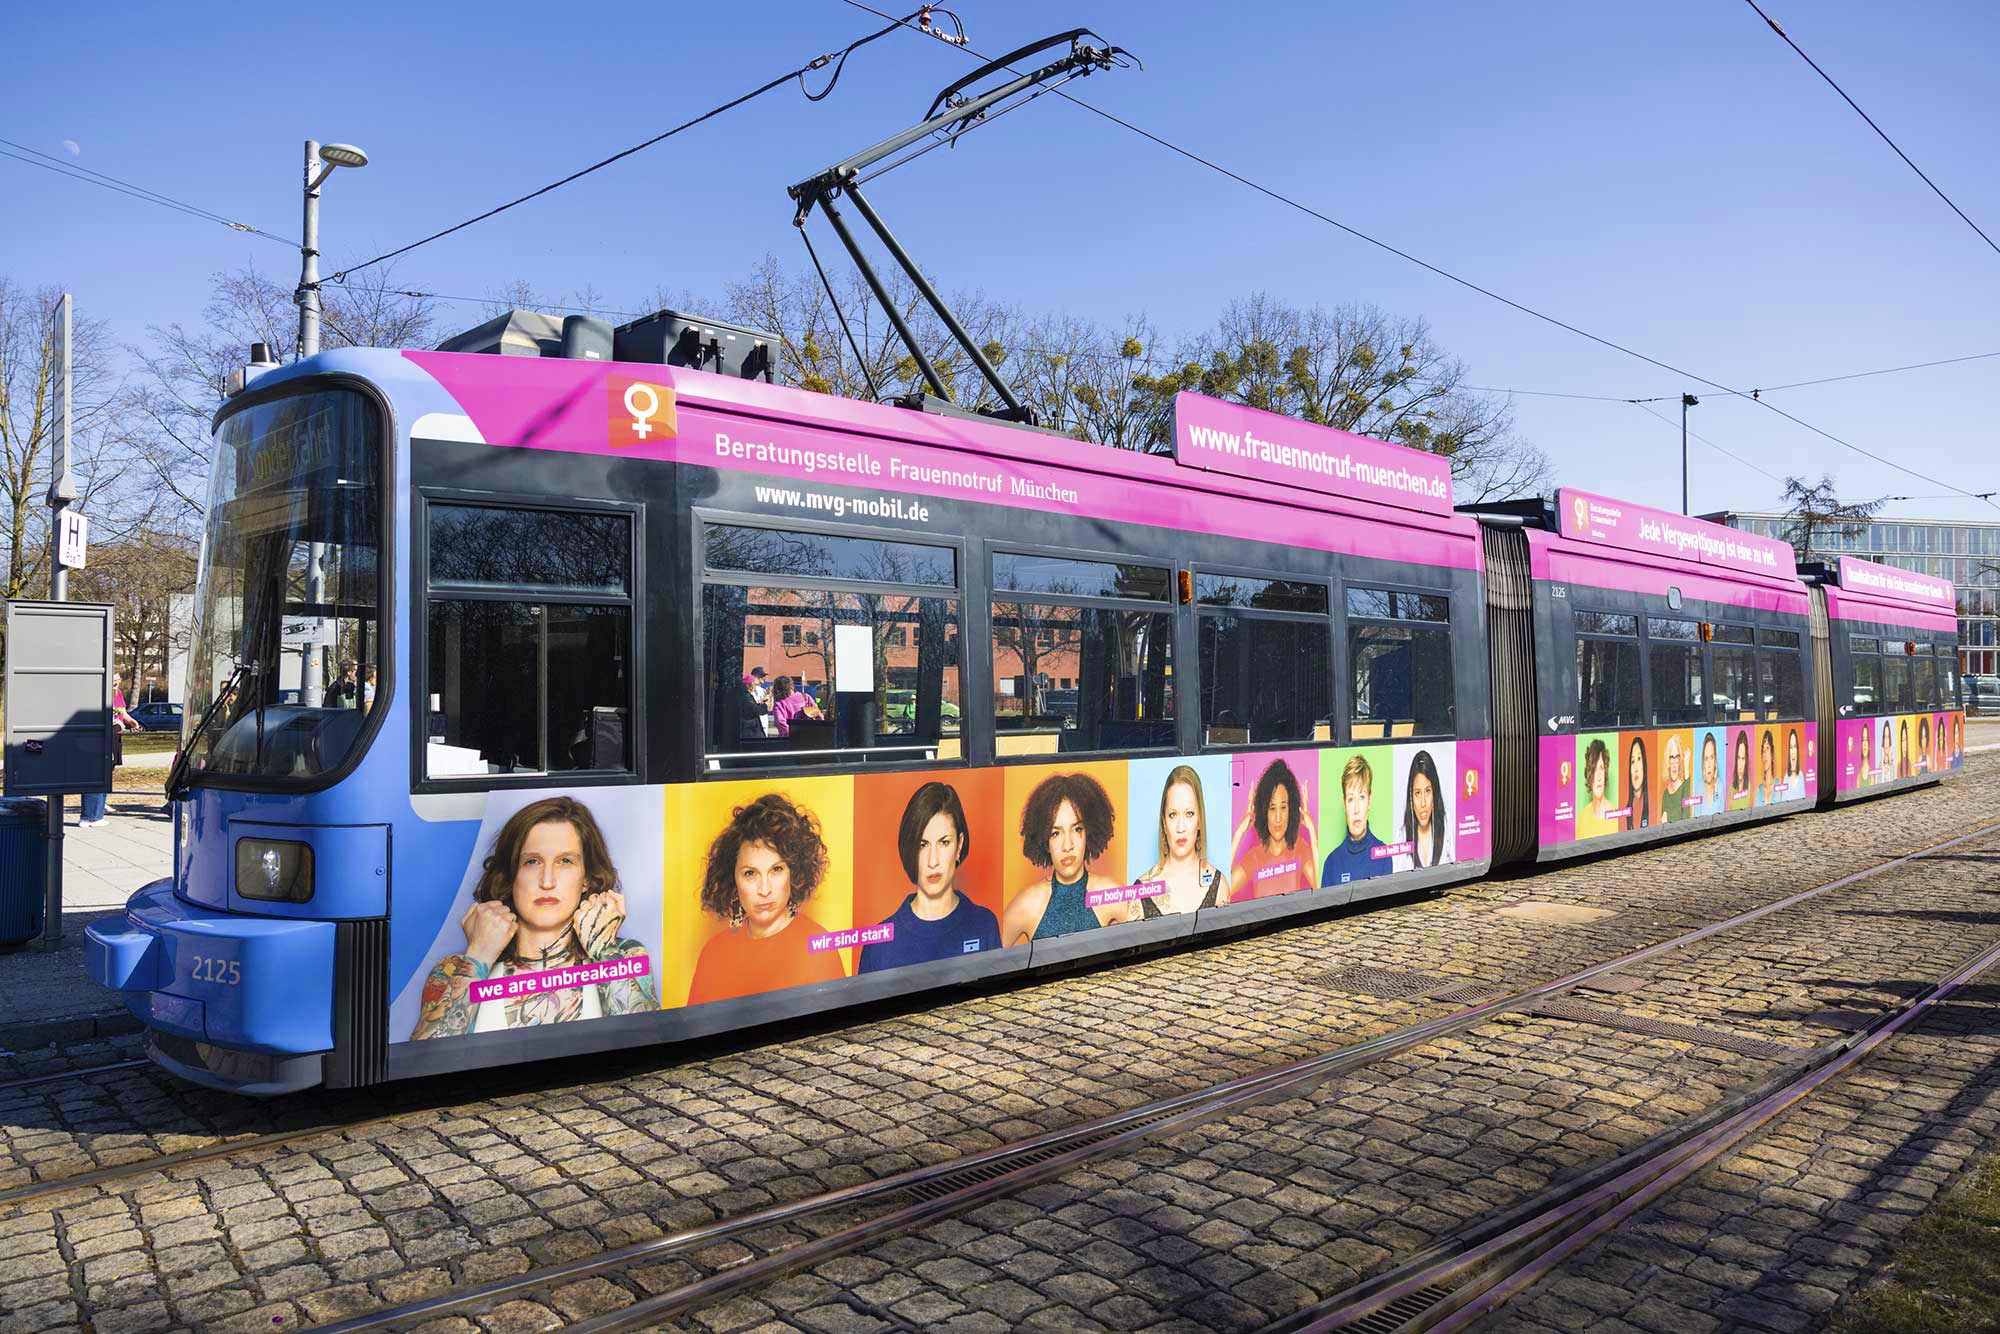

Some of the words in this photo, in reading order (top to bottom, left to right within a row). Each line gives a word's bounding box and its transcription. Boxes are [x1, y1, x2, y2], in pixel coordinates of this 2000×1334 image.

[715, 434, 881, 476] Beratungsstelle
[890, 457, 1002, 493] Frauennotruf
[1011, 476, 1078, 504] München
[1188, 424, 1447, 499] www.frauennotruf-muenchen.de
[755, 485, 929, 522] www.mvg-mobil.de
[69, 516, 80, 547] H
[1638, 517, 1661, 542] Jede
[1662, 523, 1725, 560] Vergewaltigung
[1726, 539, 1735, 559] ist
[1737, 542, 1752, 560] eine
[1752, 548, 1762, 563] zu
[1551, 586, 1565, 598] 2125
[1558, 715, 1575, 725] MVG
[1375, 847, 1386, 857] Nein
[1399, 843, 1411, 854] Nein
[1257, 868, 1273, 879] nicht
[1274, 866, 1284, 876] mit
[1285, 863, 1297, 873] uns
[1090, 893, 1102, 905] my
[1105, 889, 1124, 902] body
[1126, 887, 1138, 900] my
[1139, 884, 1162, 896] choice
[811, 935, 831, 950] wir
[834, 931, 859, 947] sind
[861, 926, 890, 942] stark
[191, 955, 241, 986] 2125
[477, 982, 504, 1000] we
[507, 976, 538, 995] are
[541, 959, 643, 989] unbreakable
